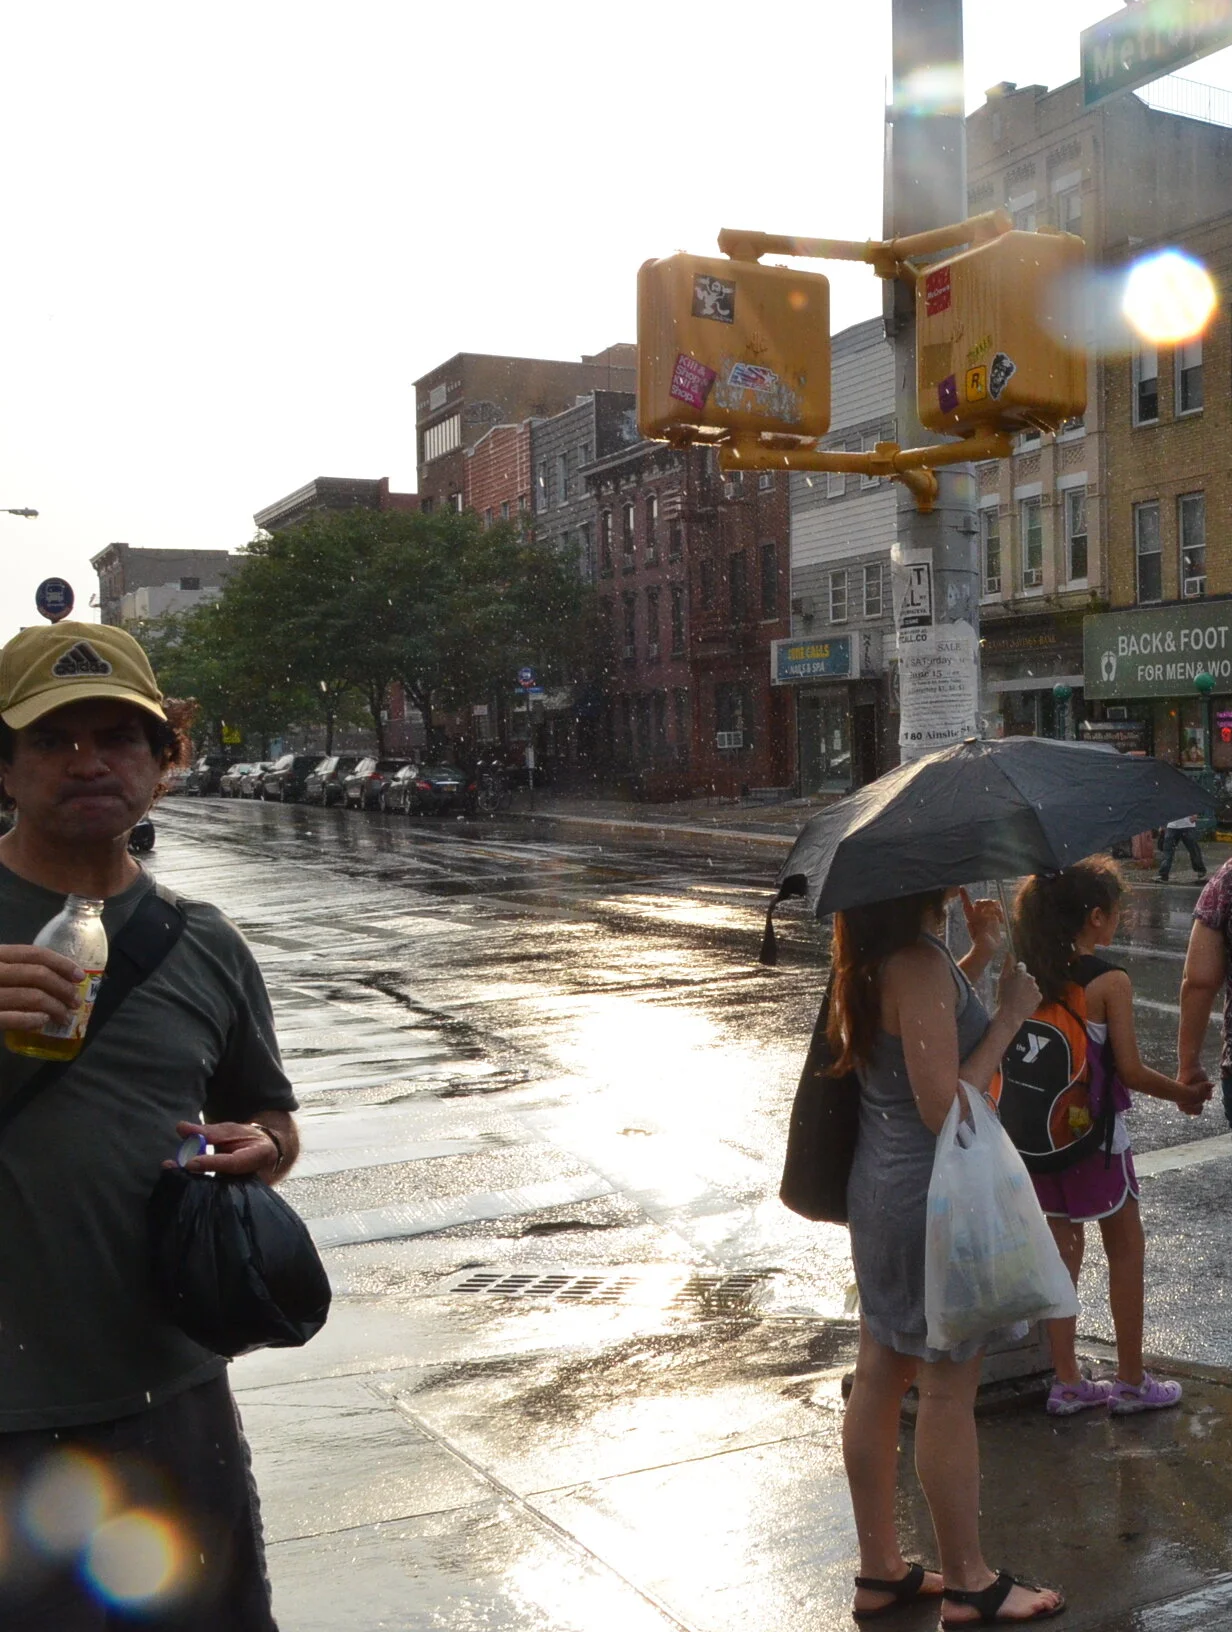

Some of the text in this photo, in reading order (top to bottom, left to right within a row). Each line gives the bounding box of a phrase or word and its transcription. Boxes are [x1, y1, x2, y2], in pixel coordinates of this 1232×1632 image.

[679, 355, 698, 371] Kill
[1180, 627, 1230, 650] FOOT
[1137, 664, 1163, 681] FOR
[904, 732, 923, 740] 180
